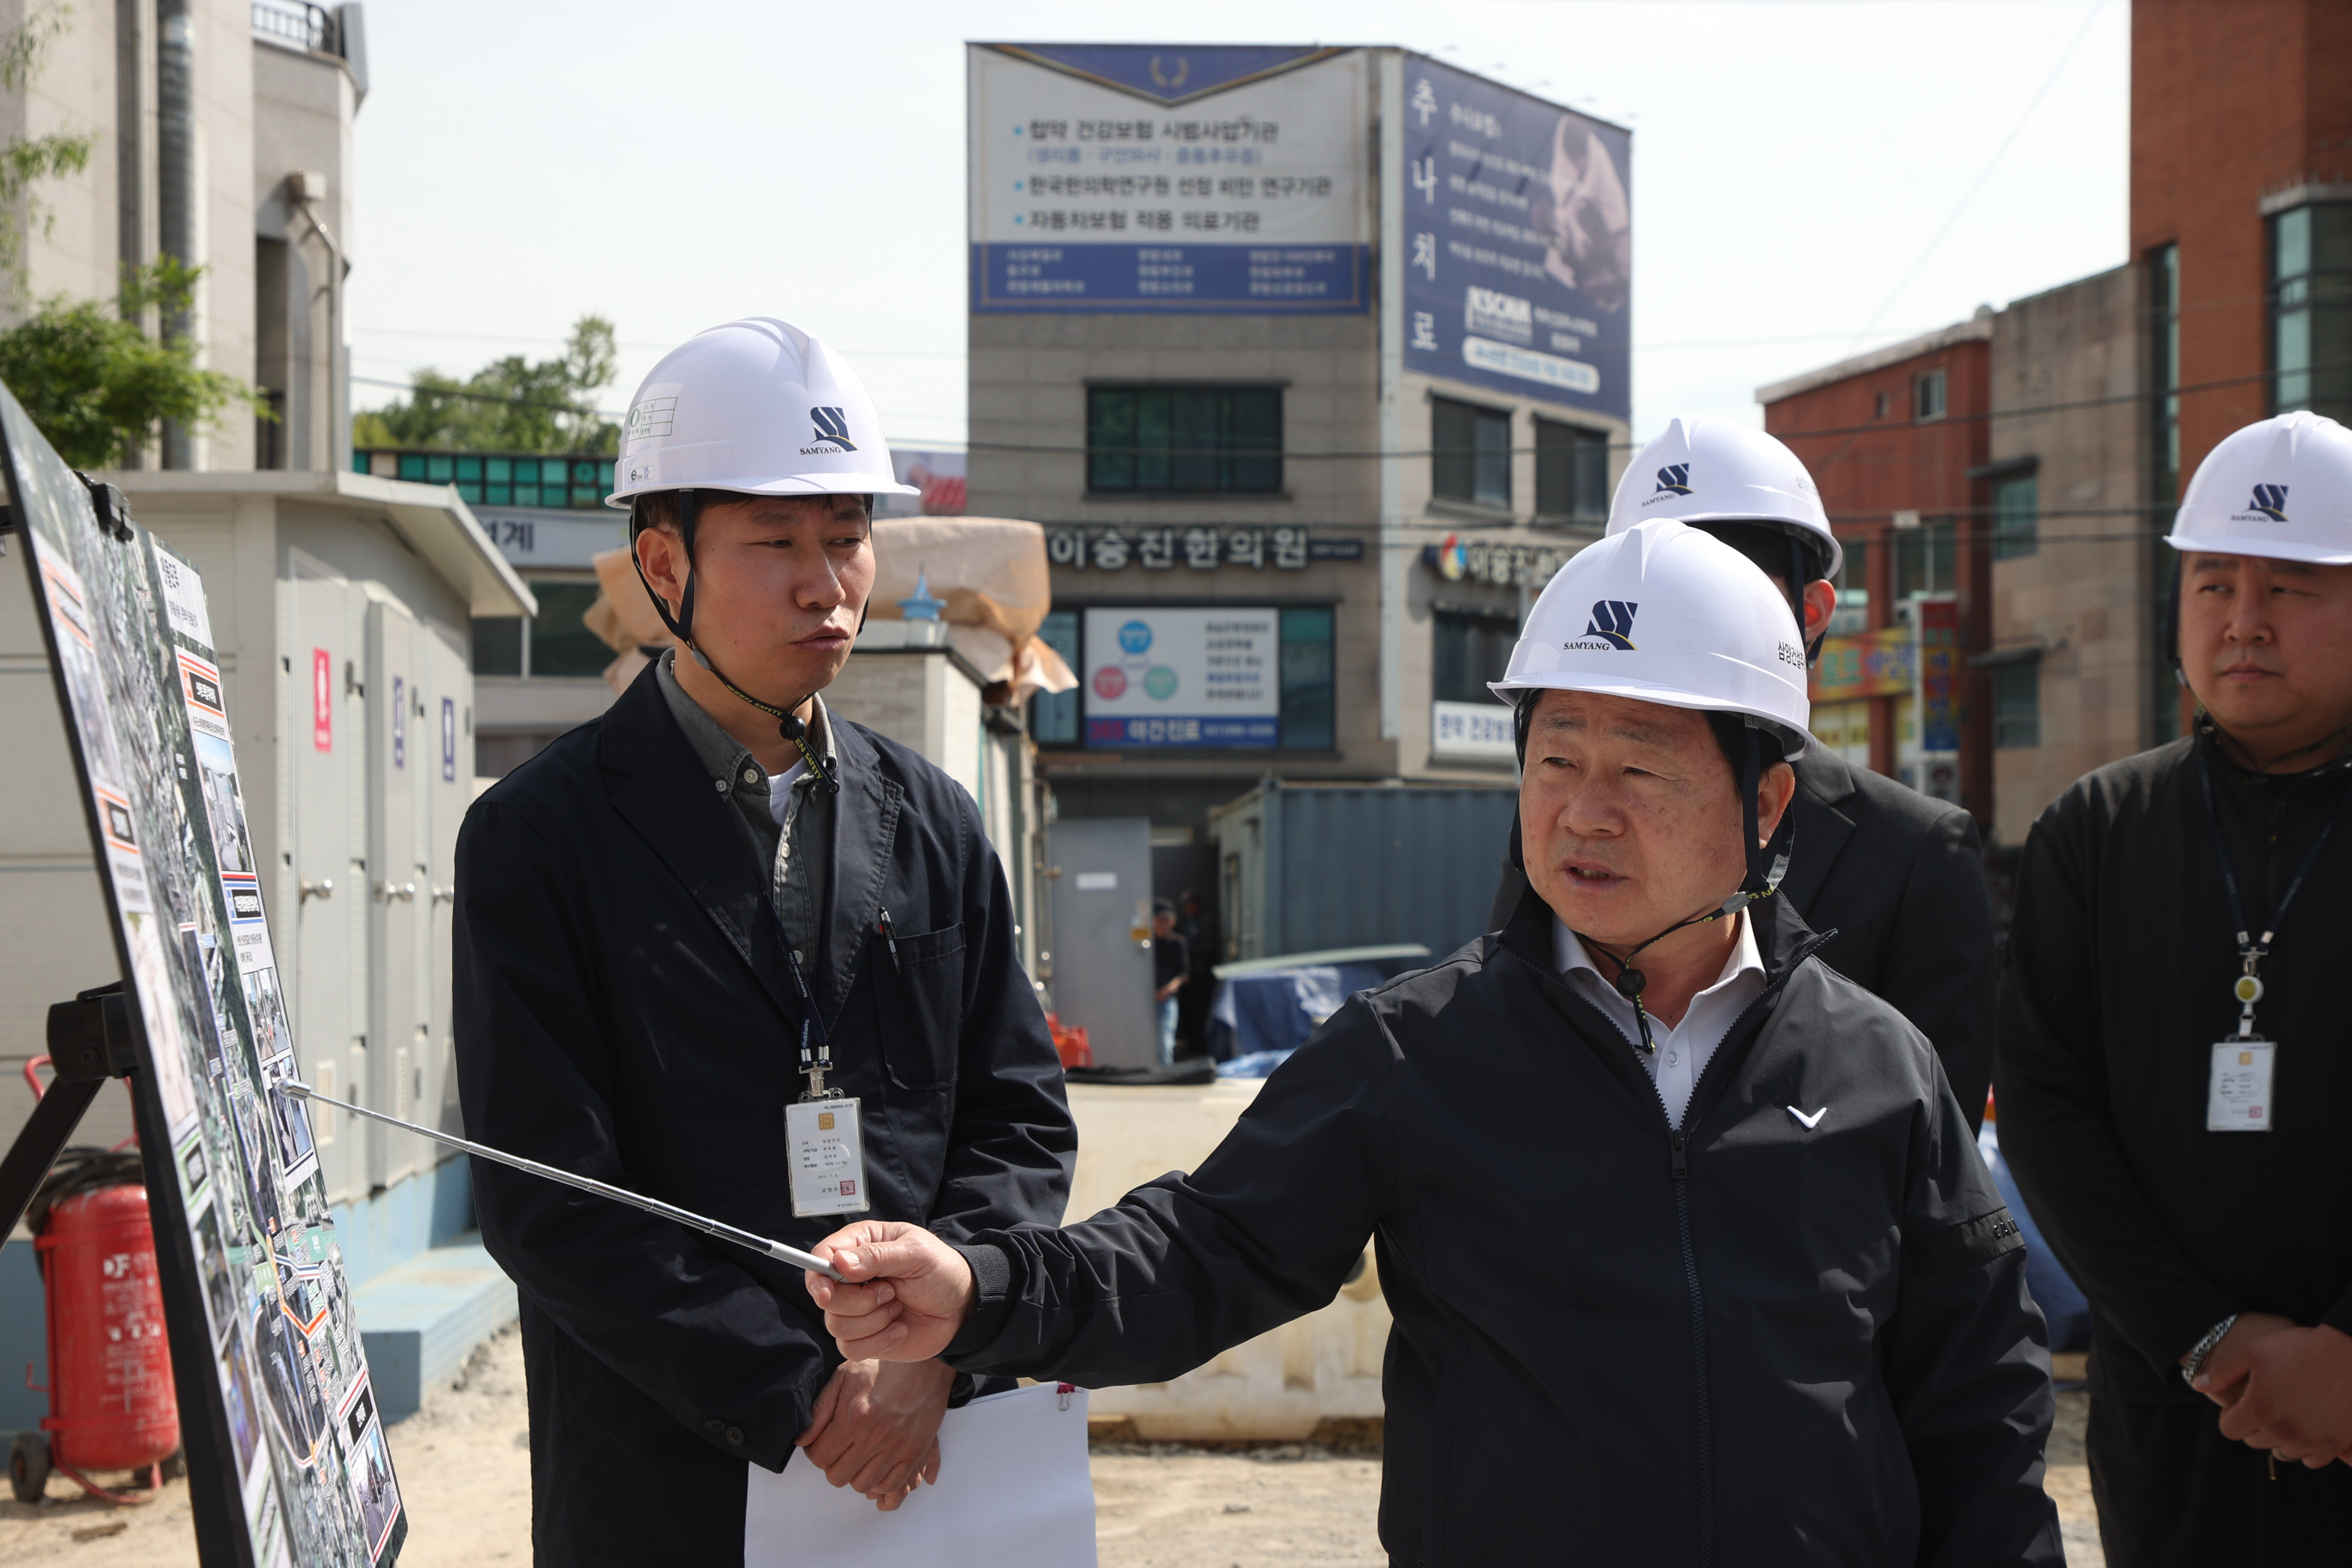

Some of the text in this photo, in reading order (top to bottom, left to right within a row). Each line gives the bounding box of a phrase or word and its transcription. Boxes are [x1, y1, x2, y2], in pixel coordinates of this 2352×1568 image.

[1078, 120, 1153, 141] 건강보험
[1161, 120, 1279, 143] 시범사업기관
[1219, 177, 1254, 197] 비만
[1261, 176, 1332, 198] 연구기관
[1030, 210, 1127, 230] 자동차보험
[1181, 211, 1260, 232] 의료기관
[800, 447, 841, 455] SAMYANG
[1642, 493, 1675, 507] SAMYANG
[1050, 527, 1309, 570] 이승진한의원
[1563, 642, 1610, 651] SAMYANG
[1778, 640, 1806, 672] 삼양건설주
[754, 703, 783, 716] SAFETY
[1128, 719, 1201, 742] 야간진료
[795, 737, 823, 779] EN SAFETY
[794, 965, 808, 998] Namyangju
[1635, 994, 1647, 1020] AFETY
